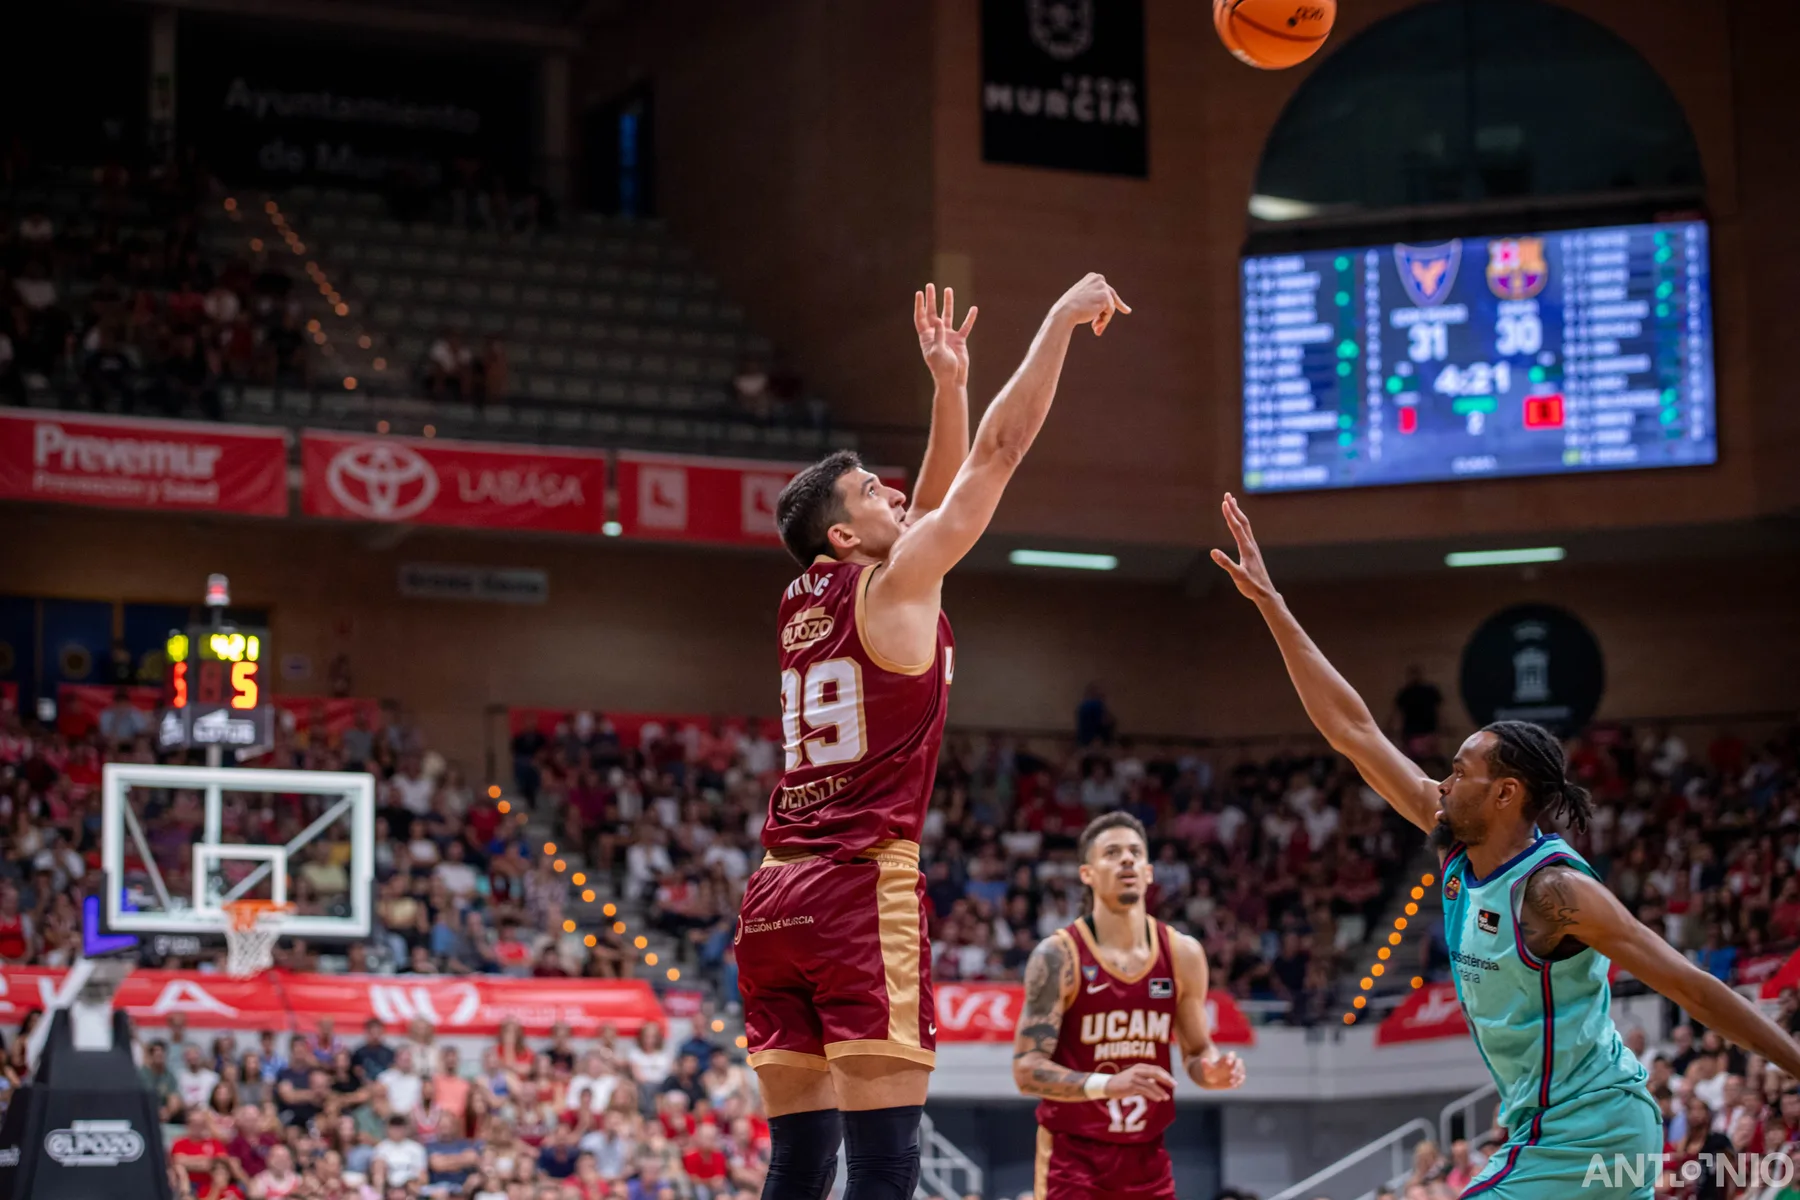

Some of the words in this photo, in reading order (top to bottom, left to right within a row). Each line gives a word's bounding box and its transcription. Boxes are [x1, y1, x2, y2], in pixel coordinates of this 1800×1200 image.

[222, 77, 481, 133] Ayuntamiento
[984, 81, 1141, 127] MURCIA
[258, 137, 305, 173] de
[1408, 322, 1449, 361] 31
[1495, 314, 1543, 355] 30
[34, 422, 222, 479] Prevemur
[231, 661, 259, 710] 5
[744, 923, 772, 934] REGIÓN
[773, 920, 782, 930] DE
[782, 916, 814, 927] MURCIA
[1081, 1009, 1171, 1044] UCAM
[1093, 1041, 1157, 1061] MURCIA
[1106, 1094, 1148, 1134] 12
